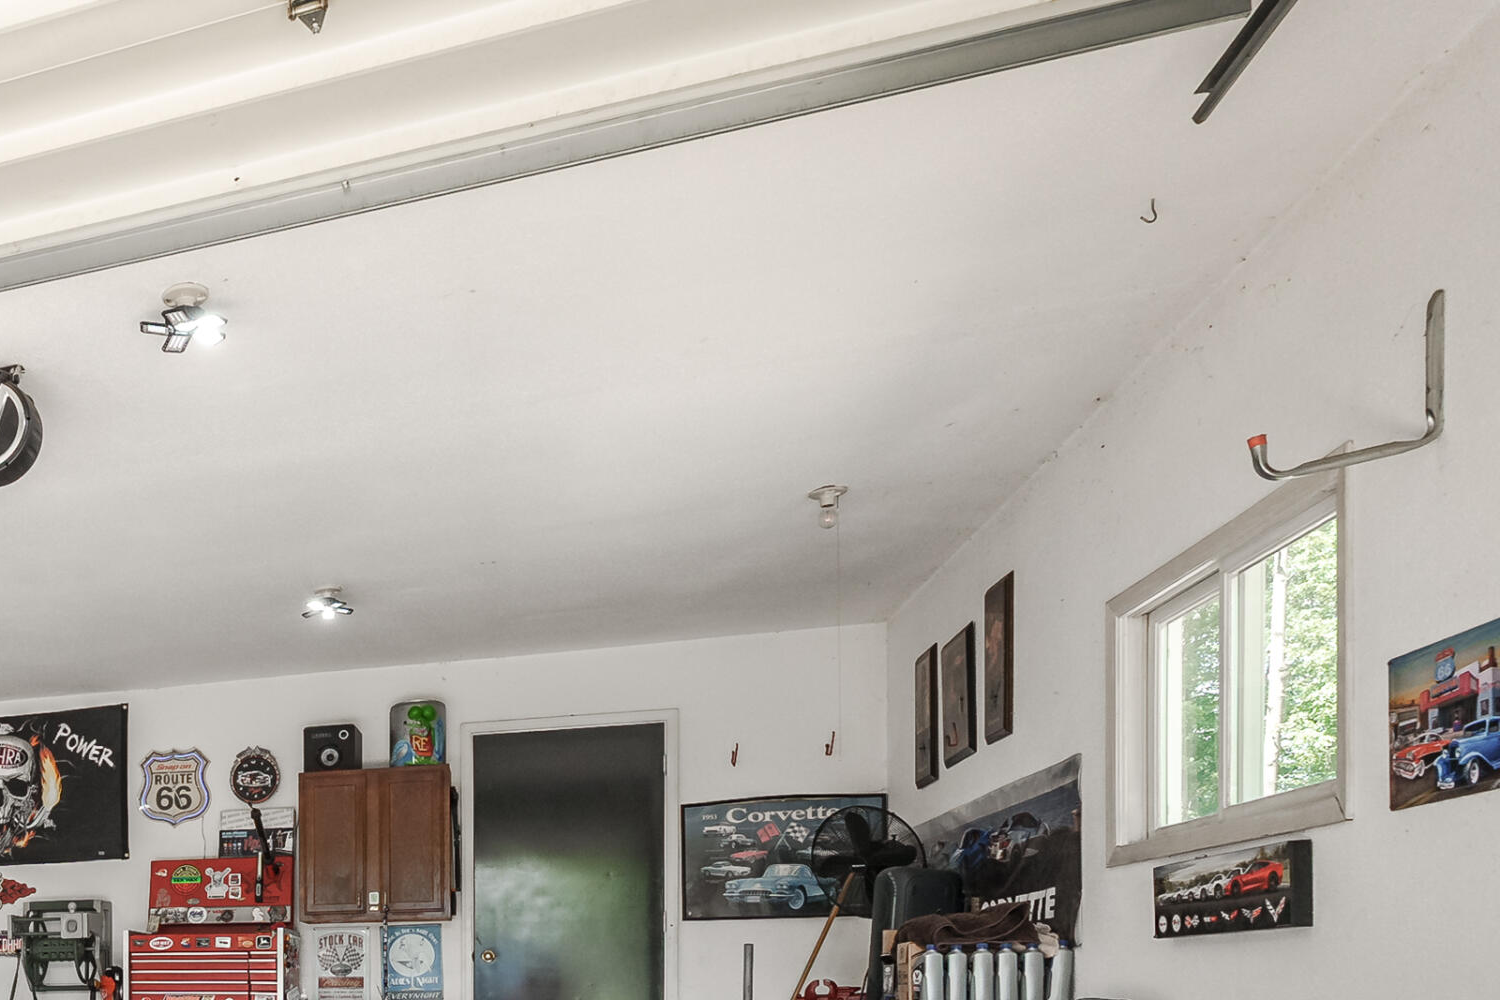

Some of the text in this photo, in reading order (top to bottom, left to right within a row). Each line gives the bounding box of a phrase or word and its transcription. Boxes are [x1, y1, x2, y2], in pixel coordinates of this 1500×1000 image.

[53, 722, 116, 768] POWER
[155, 773, 193, 785] ROUTE
[156, 785, 192, 811] 66
[725, 806, 841, 823] Corvette
[318, 934, 364, 950] STOCK CAR
